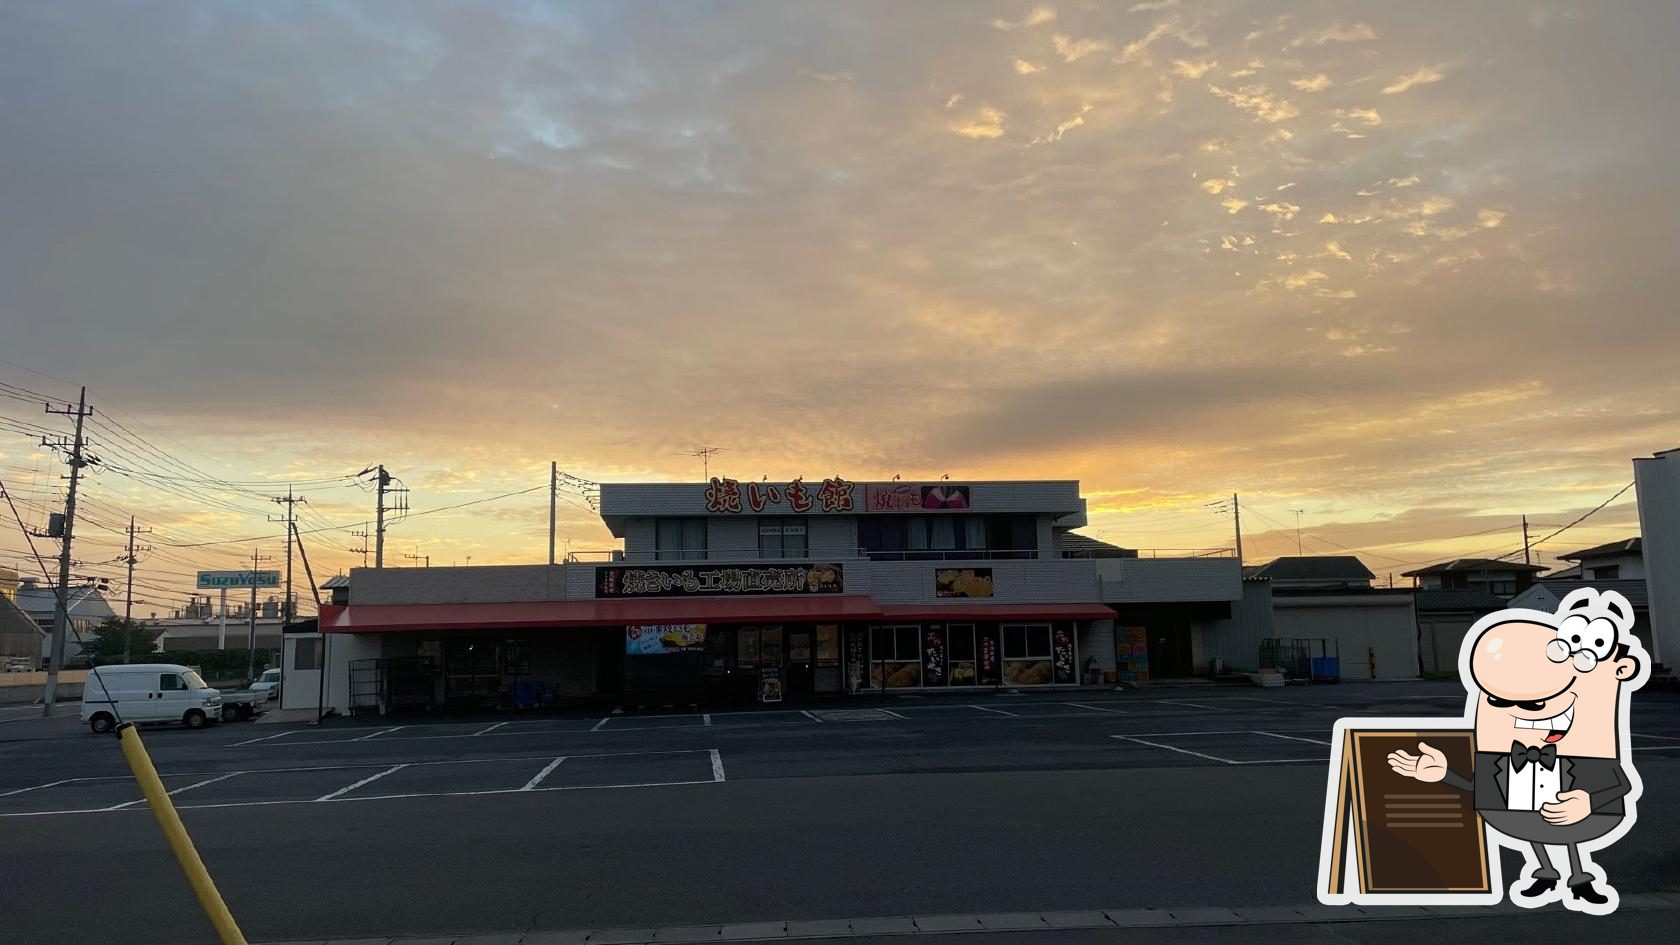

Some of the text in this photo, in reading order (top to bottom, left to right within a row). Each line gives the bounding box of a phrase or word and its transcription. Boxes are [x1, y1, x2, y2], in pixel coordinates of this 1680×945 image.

[705, 477, 855, 513] 焼いも館
[200, 573, 277, 586] SuzuYasu
[622, 567, 805, 594] 焼きいも工場直売所
